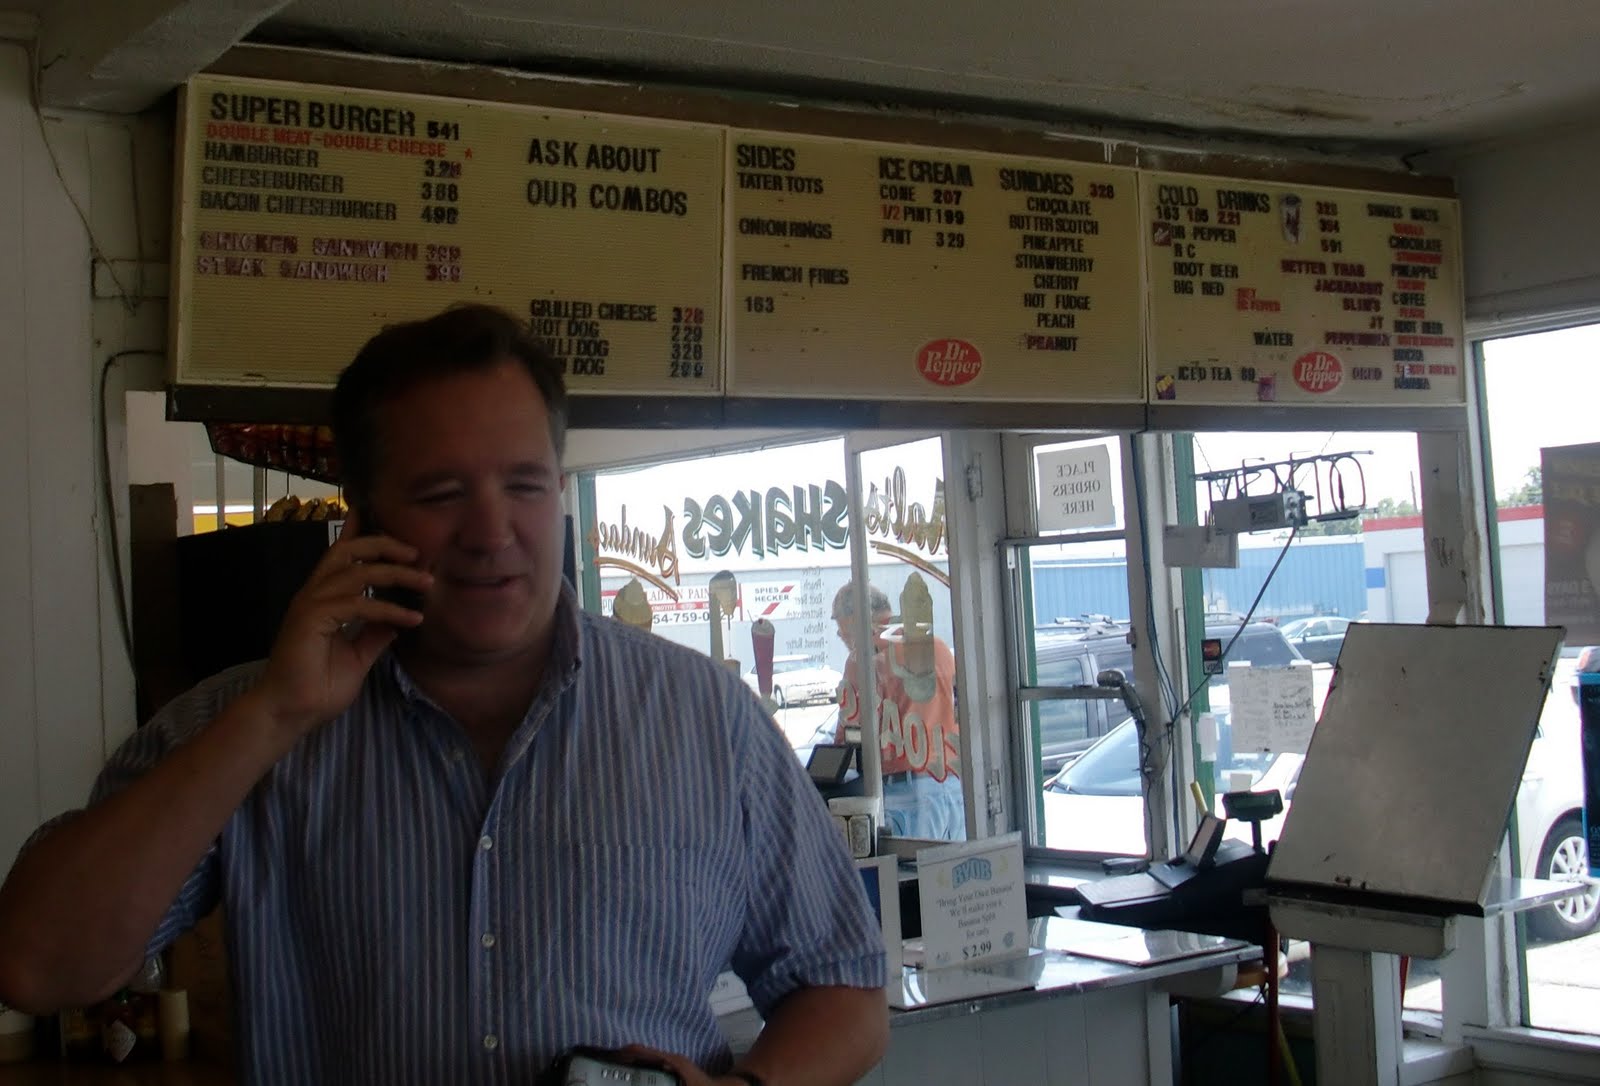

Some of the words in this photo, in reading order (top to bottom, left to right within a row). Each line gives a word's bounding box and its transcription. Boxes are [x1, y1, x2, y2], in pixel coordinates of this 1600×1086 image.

[210, 93, 300, 126] SUPER
[308, 101, 416, 136] BURGER
[427, 121, 459, 140] 541
[207, 120, 268, 141] DOUBLE
[388, 137, 446, 157] CHEESE
[204, 141, 319, 168] HAMBURGER
[528, 138, 578, 167] ASK
[586, 143, 661, 172] ABOUT
[737, 144, 795, 171] SIDES
[202, 165, 344, 193] CHEESEBURGER
[879, 157, 905, 180] ICE
[908, 160, 973, 186] CREAM
[1000, 168, 1074, 195] SUNDAES
[737, 172, 783, 191] TATER
[788, 176, 824, 194] TOTS
[880, 185, 916, 201] CONE
[200, 190, 260, 212] BACON
[266, 196, 397, 221] CHEESEBURGER
[527, 179, 577, 208] OUR
[590, 184, 687, 216] COMBOS
[1027, 197, 1092, 216] CHOCOLATE
[1159, 184, 1198, 206] COLD
[1216, 190, 1270, 213] DRINKS
[883, 204, 901, 221] 1/2
[903, 206, 931, 223] PINT
[739, 217, 787, 237] ONION
[789, 221, 832, 240] RINGS
[882, 228, 912, 245] PINT
[936, 232, 965, 248] 329
[1193, 226, 1236, 243] PEPPER
[200, 231, 298, 254] CHICKEN
[313, 237, 418, 261] SANDWICH
[1023, 234, 1084, 252] PINEAPPLE
[198, 256, 266, 277] STEAK
[280, 260, 389, 282] SANDWICH
[1016, 254, 1094, 272] STRAWBERRY
[1173, 262, 1204, 277] ROOT
[1210, 264, 1239, 279] BEER
[742, 264, 802, 283] FRENCH
[808, 267, 849, 286] FRIES
[1034, 275, 1079, 291] CHERRY
[1174, 280, 1193, 295] BIG
[1202, 281, 1224, 296] RED
[530, 299, 592, 319] GRILLED
[598, 303, 657, 322] CHEESE
[1024, 293, 1046, 308] HOT
[1055, 295, 1091, 310] FUDGE
[531, 319, 561, 336] HOT
[567, 321, 599, 339] DOG
[1037, 313, 1075, 328] PEACH
[576, 339, 609, 357] DOG
[1027, 335, 1078, 350] PEANUT
[1254, 332, 1294, 346] WATER
[944, 341, 969, 361] Dr
[573, 357, 605, 375] DOG
[923, 351, 981, 381] Pepper
[1313, 354, 1333, 370] Dr
[1212, 367, 1232, 381] TEA
[1299, 361, 1342, 389] Pepper
[754, 586, 780, 595] SPIES
[754, 594, 790, 603] HECKER
[952, 857, 992, 890] BYOB
[958, 892, 974, 904] Your
[968, 902, 986, 913] make
[971, 941, 992, 958] 2.99
